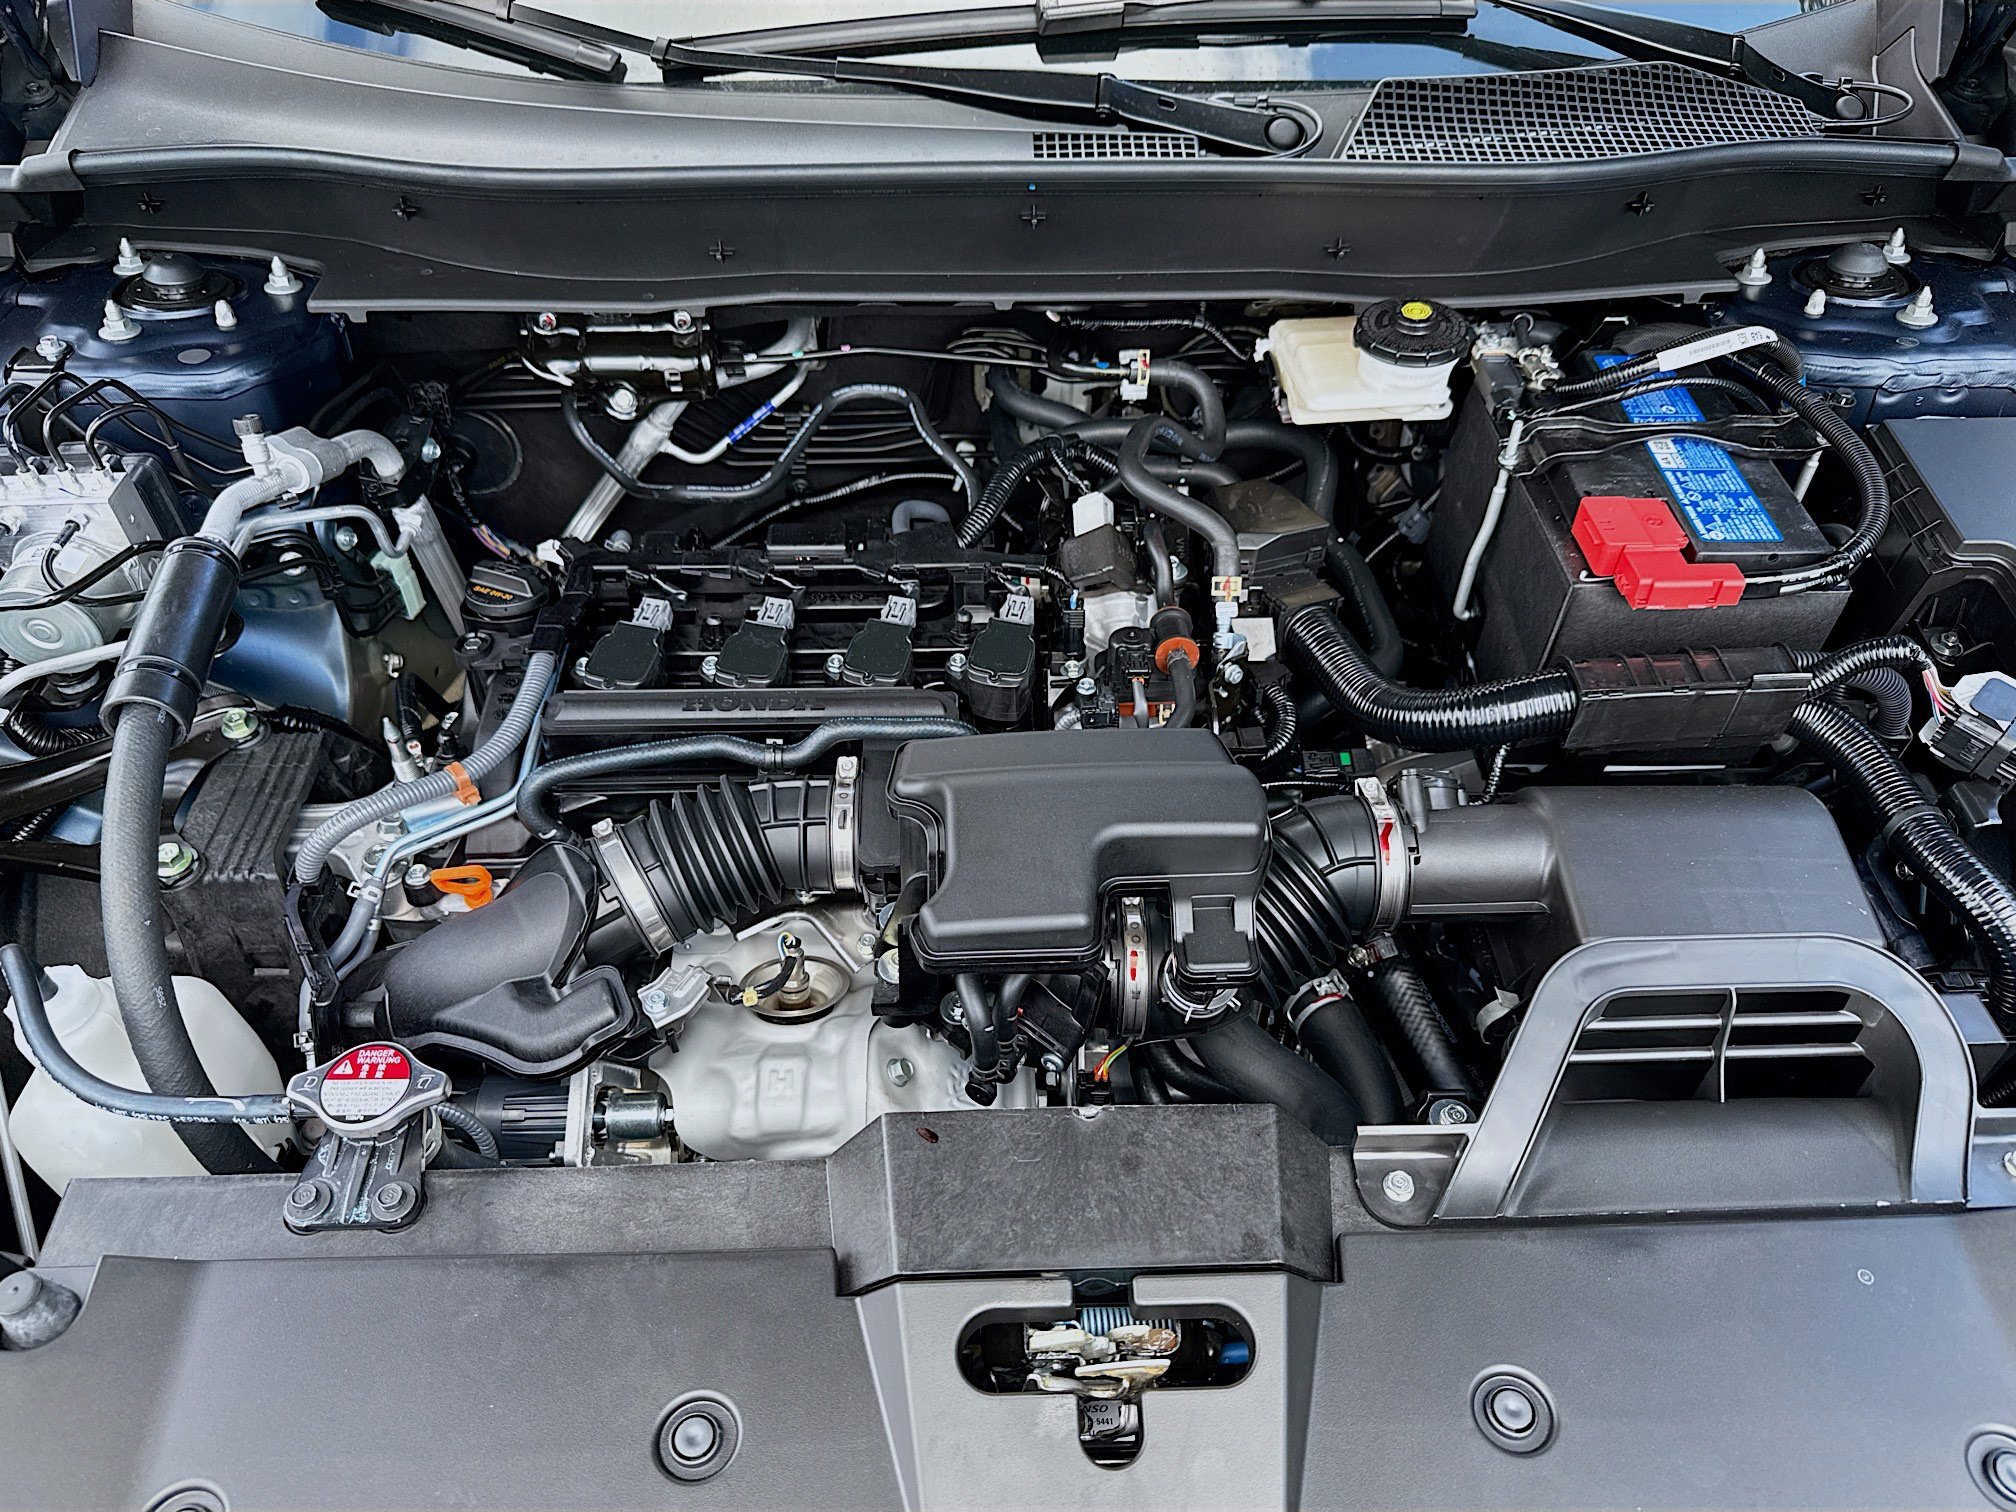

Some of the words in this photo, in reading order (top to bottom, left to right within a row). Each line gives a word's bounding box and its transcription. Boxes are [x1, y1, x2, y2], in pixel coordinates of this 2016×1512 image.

[473, 585, 491, 594] SAE
[682, 697, 826, 712] HONDA
[358, 1049, 396, 1057] DANGER
[356, 1056, 402, 1064] WARNUNG
[1083, 1404, 1109, 1413] NSO
